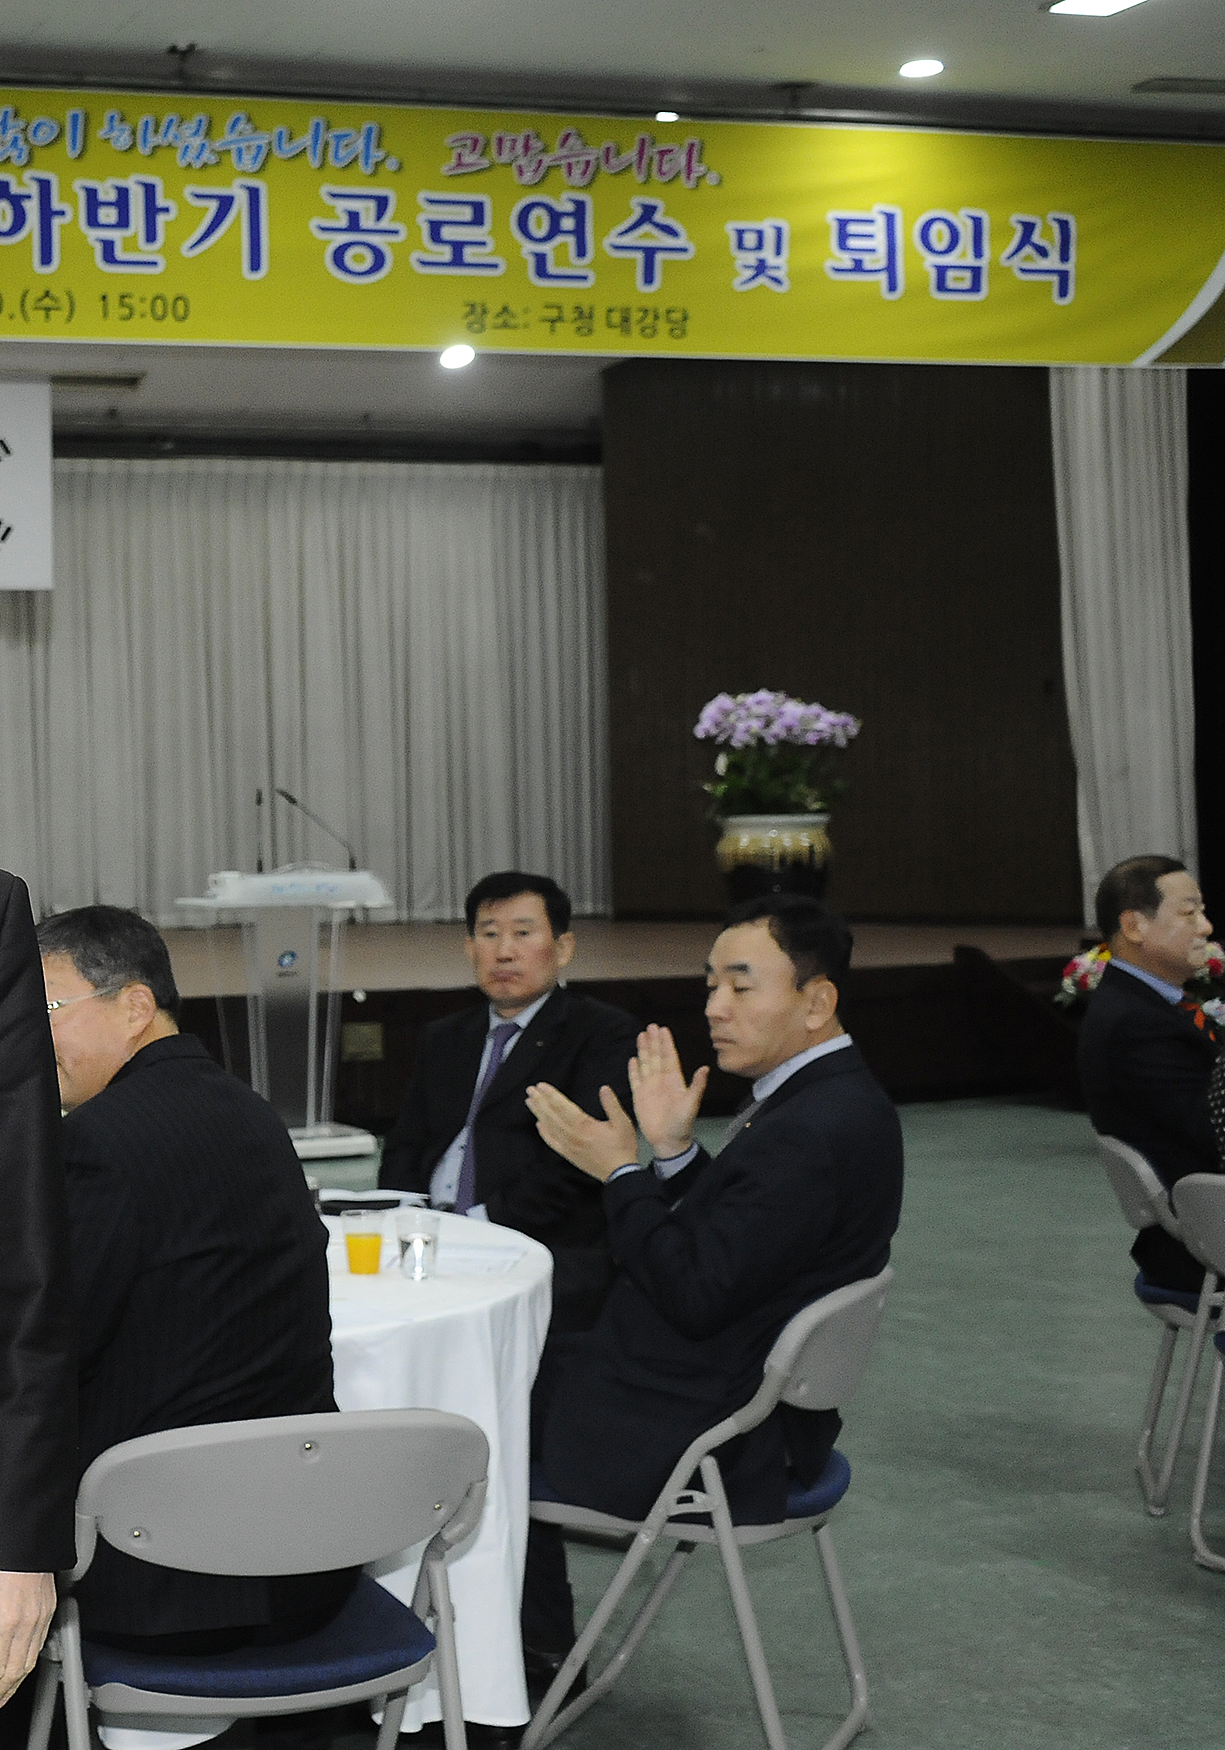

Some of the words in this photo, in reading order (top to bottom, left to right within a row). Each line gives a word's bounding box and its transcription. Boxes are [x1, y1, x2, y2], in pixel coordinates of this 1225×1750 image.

[97, 110, 401, 175] 하셨습니다.
[441, 128, 722, 189] 고맙습니다.
[311, 183, 695, 293] 공로연수
[727, 217, 790, 293] 및
[826, 204, 1076, 305] 퇴임식
[98, 291, 192, 323] 15:00
[462, 301, 531, 335] 장소:
[538, 303, 595, 338] 구청
[605, 305, 690, 340] 대강당
